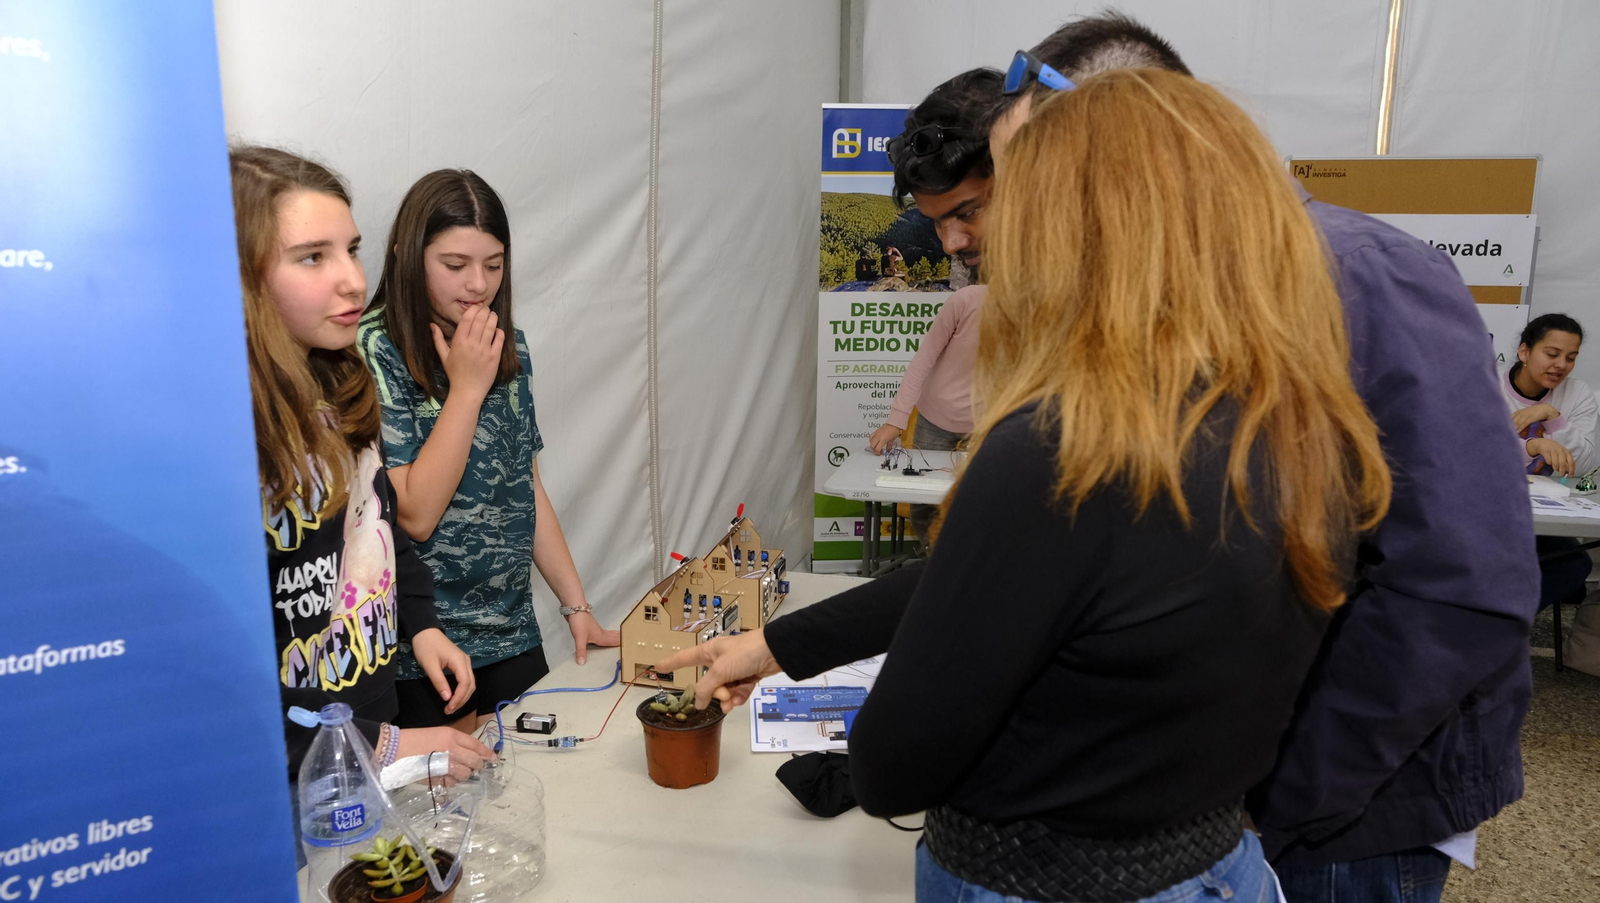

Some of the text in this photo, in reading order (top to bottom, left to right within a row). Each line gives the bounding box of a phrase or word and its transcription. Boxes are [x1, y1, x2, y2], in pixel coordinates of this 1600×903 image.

[1420, 239, 1502, 256] evada
[829, 320, 856, 334] TU
[834, 337, 901, 352] MEDIO
[835, 364, 907, 374] FP AGRARIA
[835, 381, 901, 391] Aprovechami
[871, 390, 886, 398] del
[863, 412, 868, 420] y
[276, 551, 338, 595] HAPPY
[275, 584, 337, 632] TODA
[334, 806, 362, 820] Font
[87, 815, 154, 846] libres
[334, 817, 363, 830] Vella
[27, 874, 45, 901] y
[51, 846, 153, 888] servidor
